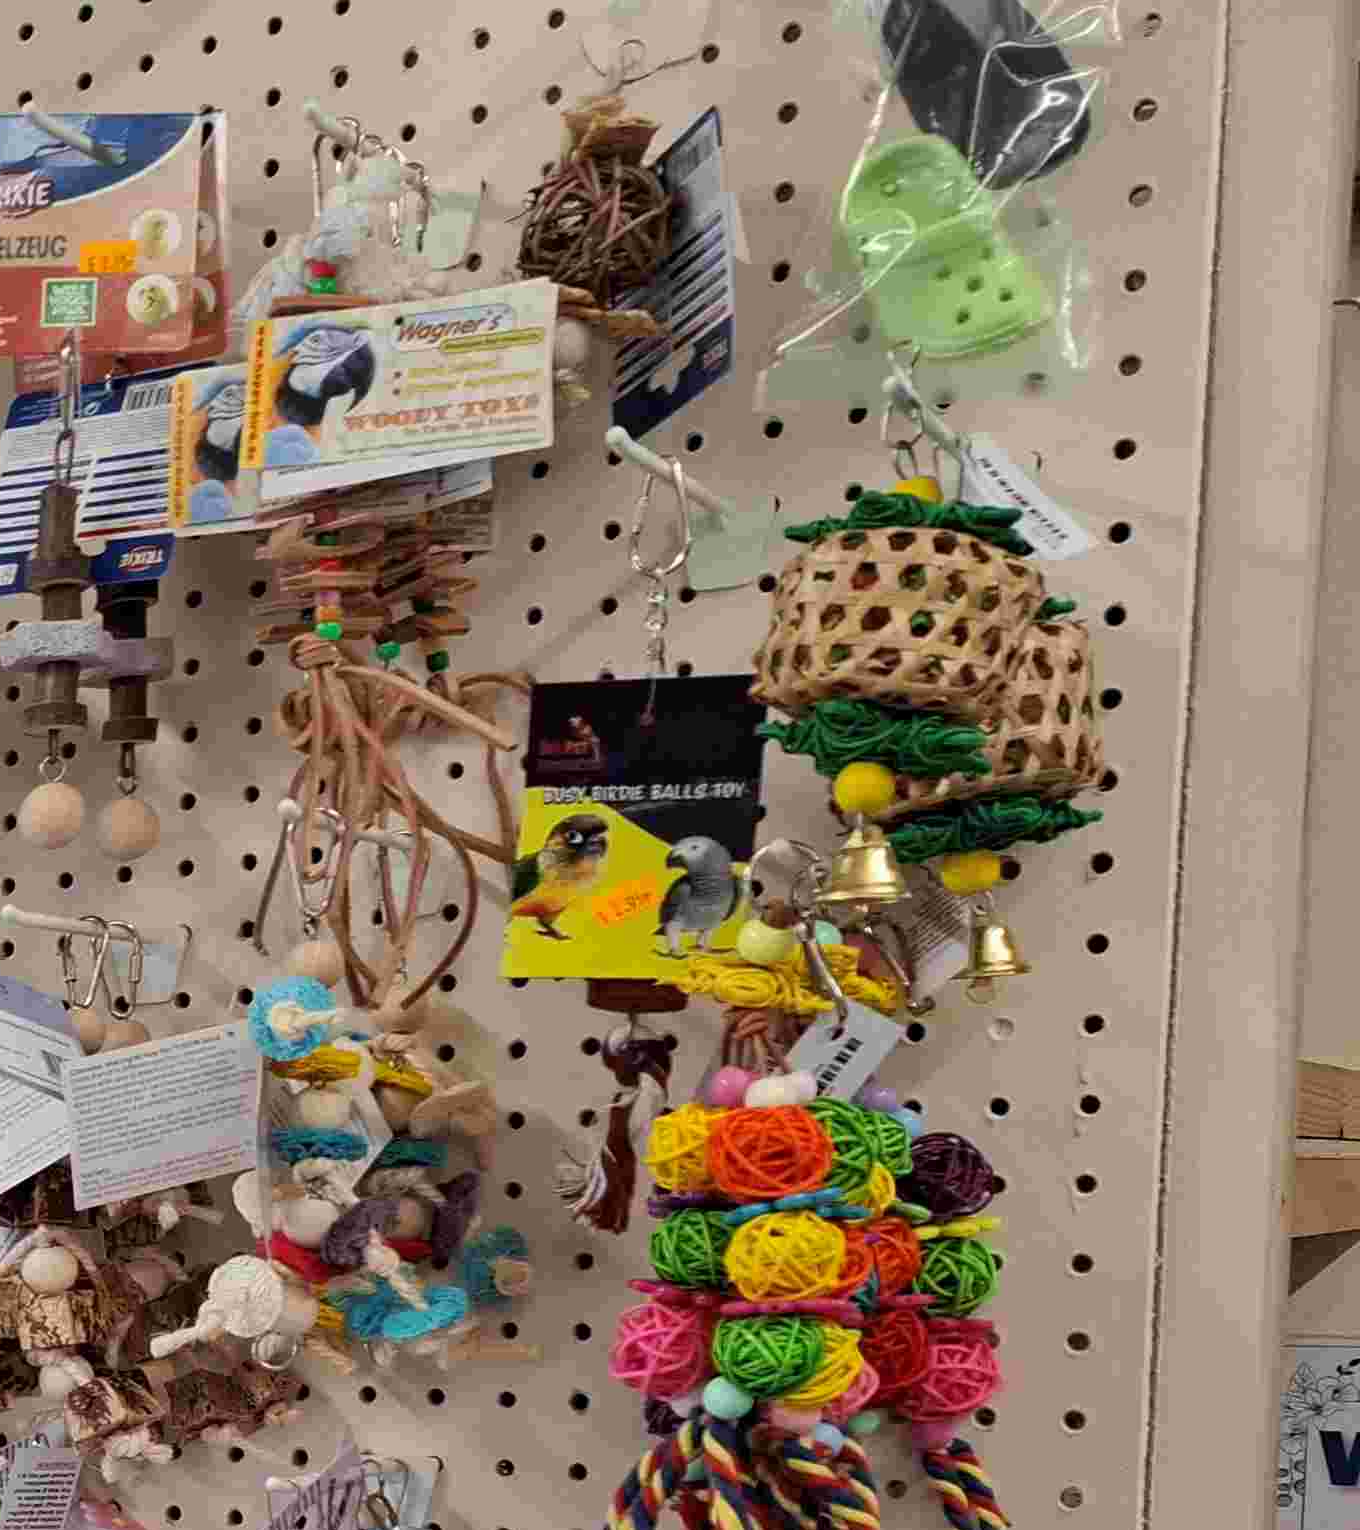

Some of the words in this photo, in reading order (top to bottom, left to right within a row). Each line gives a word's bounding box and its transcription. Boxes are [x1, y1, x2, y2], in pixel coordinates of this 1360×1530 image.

[397, 308, 504, 346] Wagner's
[543, 786, 586, 804] BUSY
[591, 785, 644, 803] BIRDIE
[650, 784, 704, 802] BALLS
[710, 780, 746, 799] TOY
